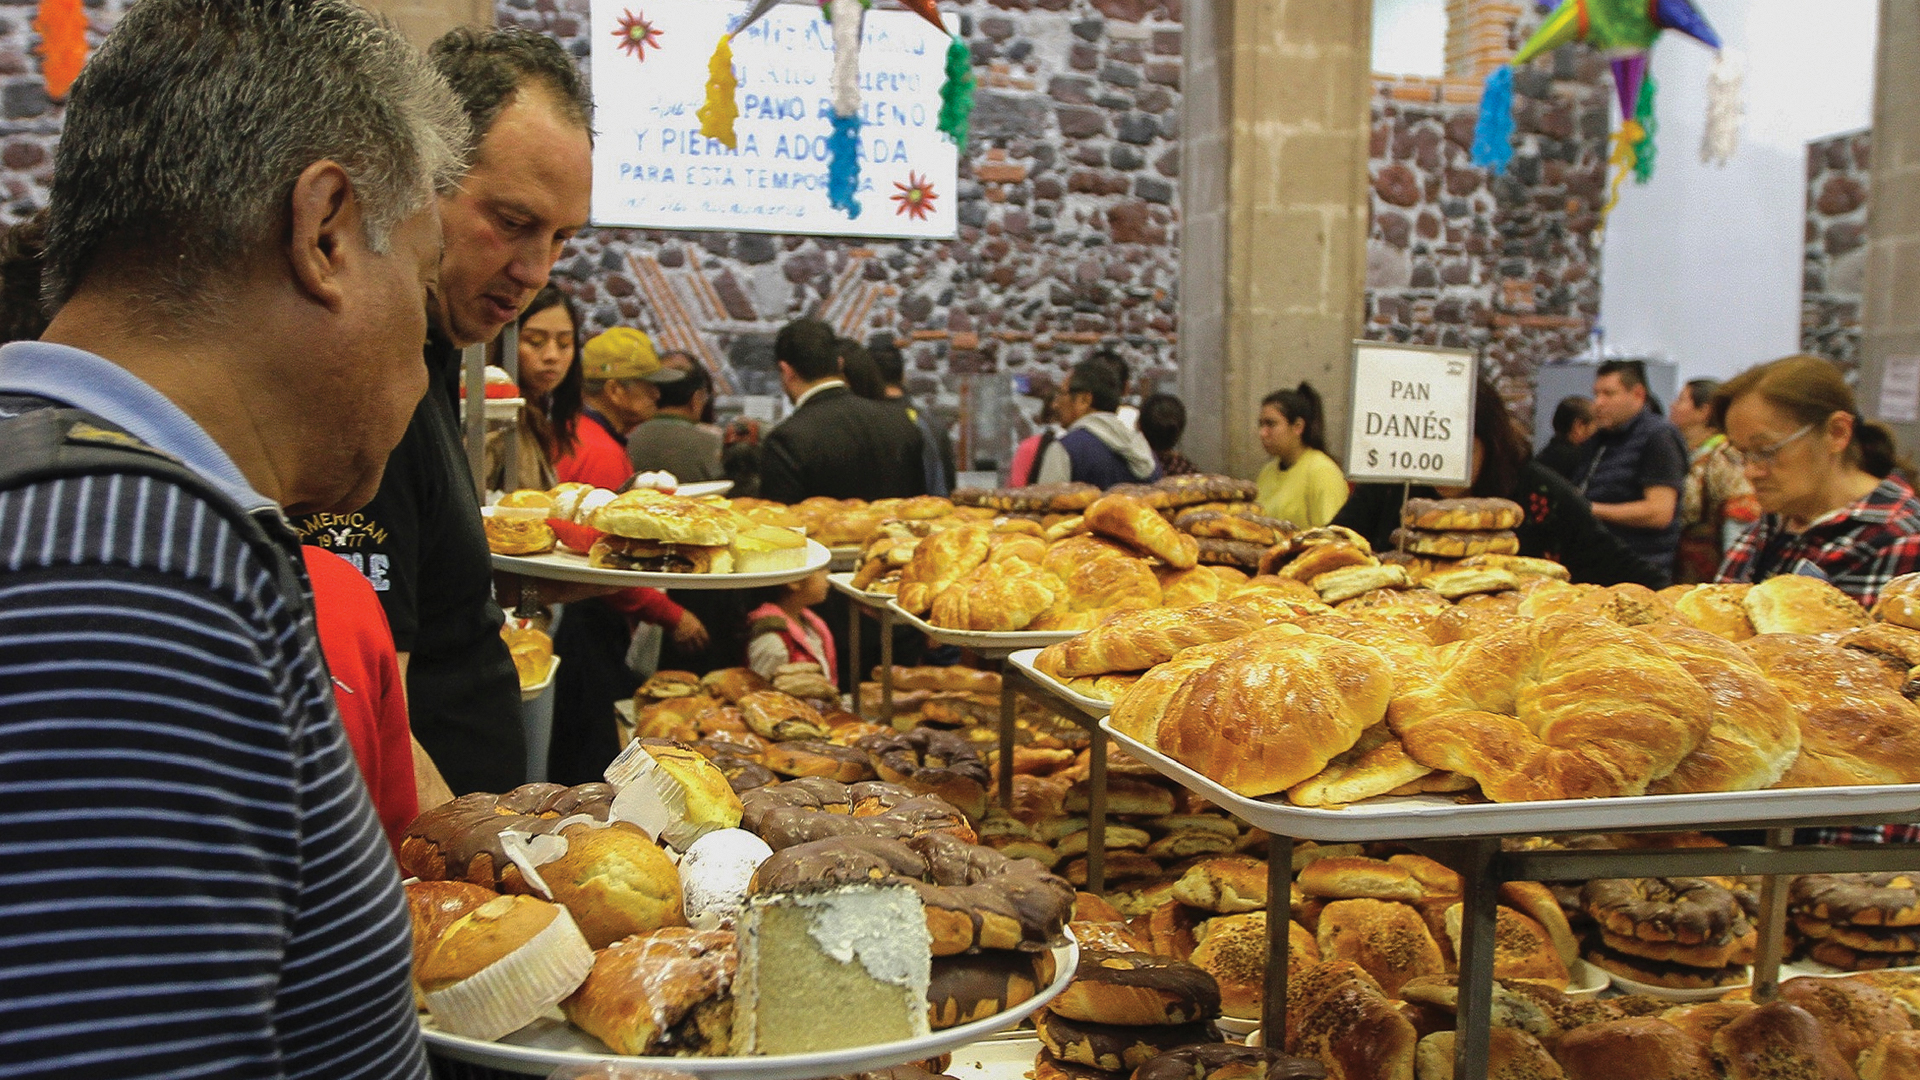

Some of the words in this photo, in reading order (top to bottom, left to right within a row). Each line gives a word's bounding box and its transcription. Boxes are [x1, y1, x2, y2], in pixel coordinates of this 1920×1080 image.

[744, 94, 805, 121] PAVO
[817, 98, 925, 127] RLENO
[634, 129, 649, 151] Y
[774, 134, 908, 163] ADOADA
[619, 162, 675, 183] PARA
[685, 166, 735, 187] ESTA
[745, 168, 875, 193] TEMPORA
[1390, 380, 1430, 401] PAN
[1365, 410, 1452, 441] DANÉS
[1367, 448, 1379, 468] $
[1389, 451, 1444, 471] 10.00
[298, 512, 389, 545] AMERICAN
